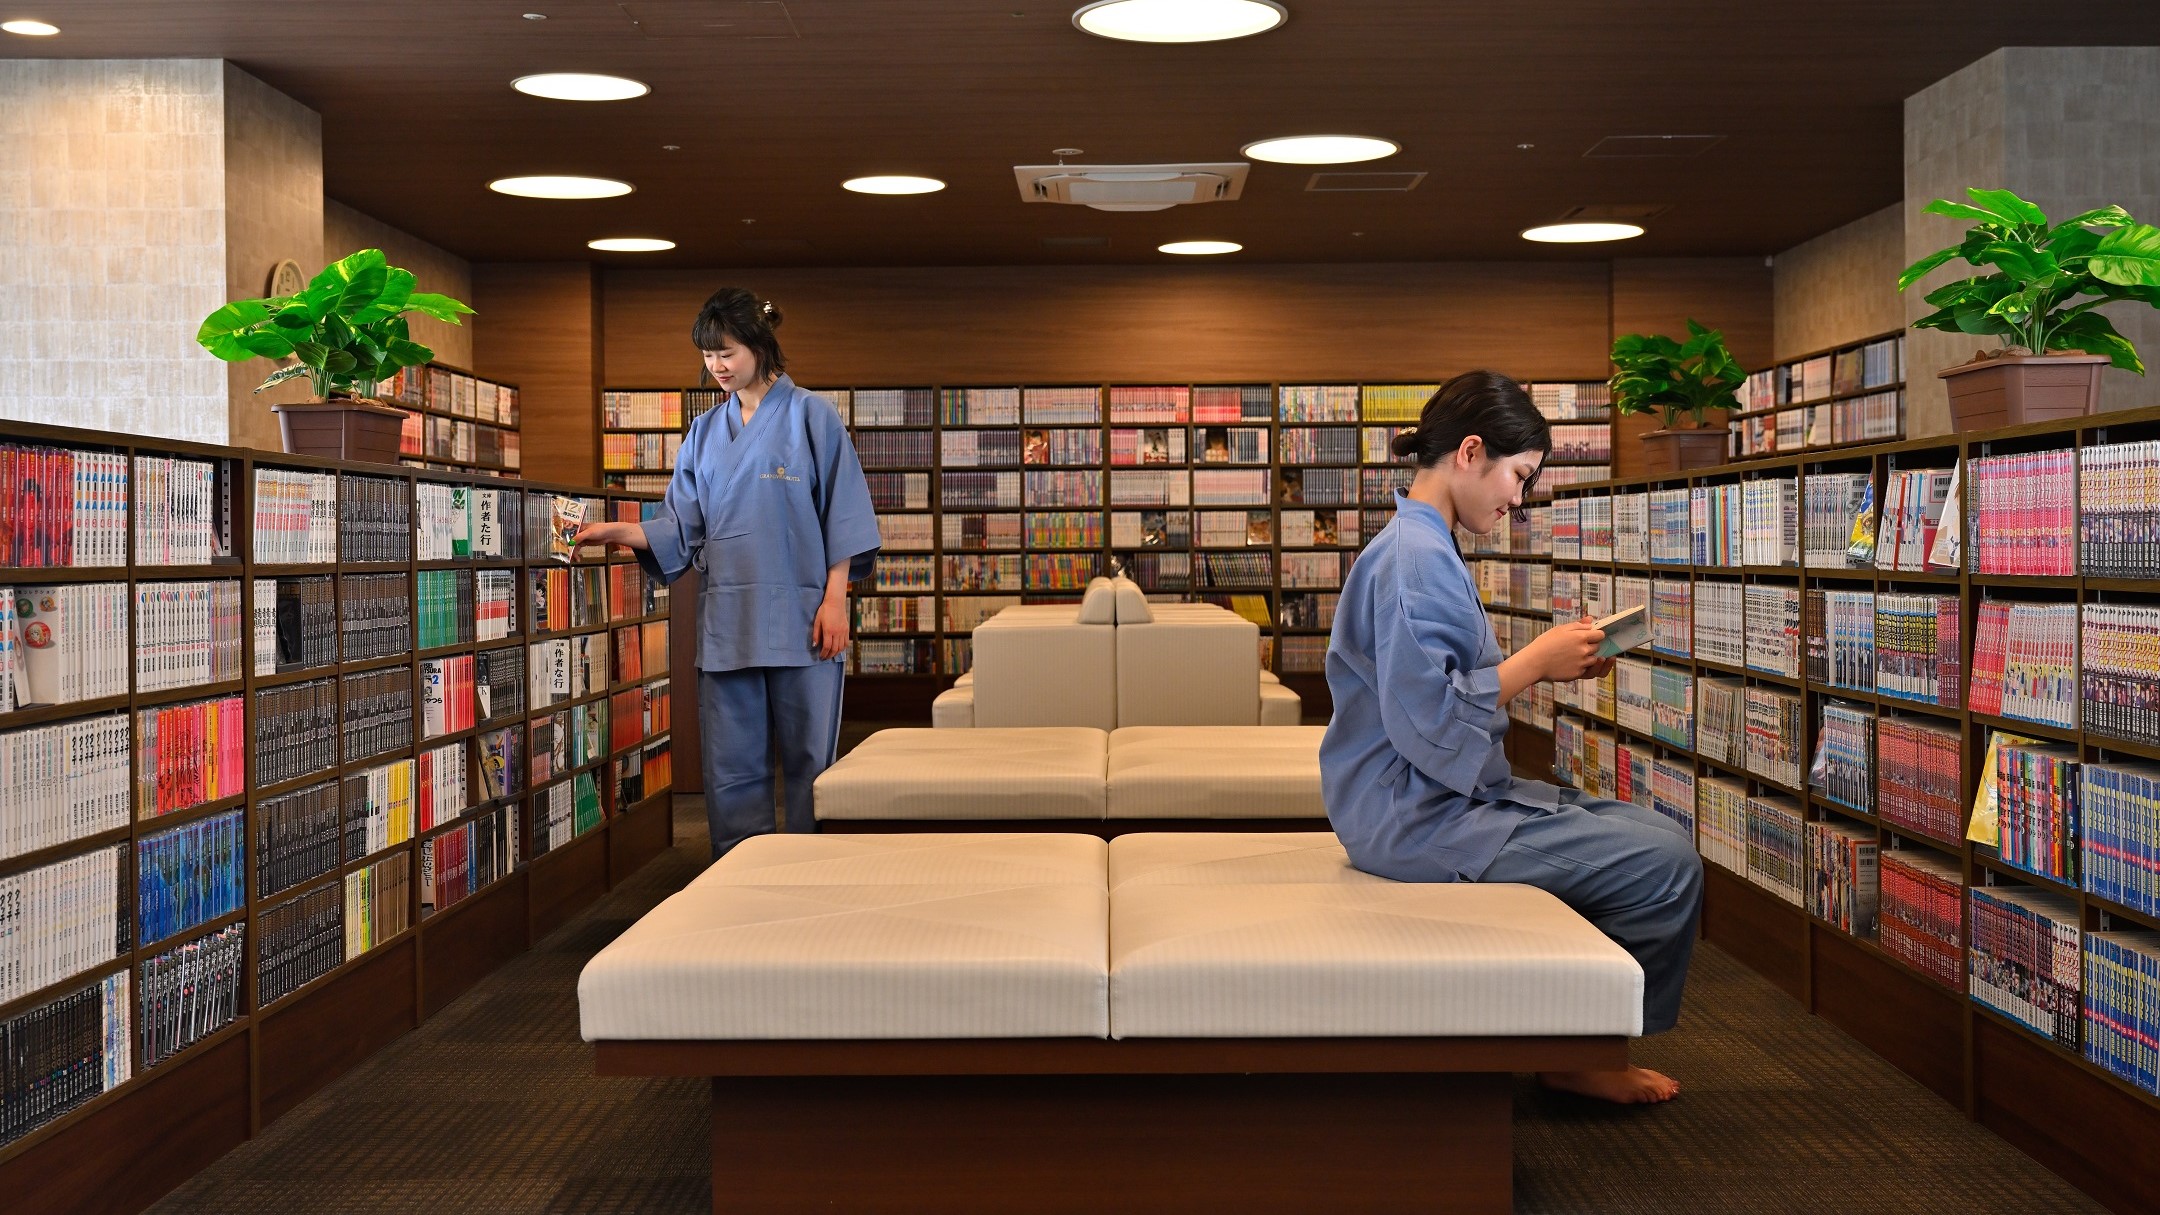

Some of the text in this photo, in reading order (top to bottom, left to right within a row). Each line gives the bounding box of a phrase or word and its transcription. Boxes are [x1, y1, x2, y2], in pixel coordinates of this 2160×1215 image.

[480, 500, 492, 546] 作者た行
[432, 675, 439, 684] 2
[554, 649, 564, 688] 作者な行
